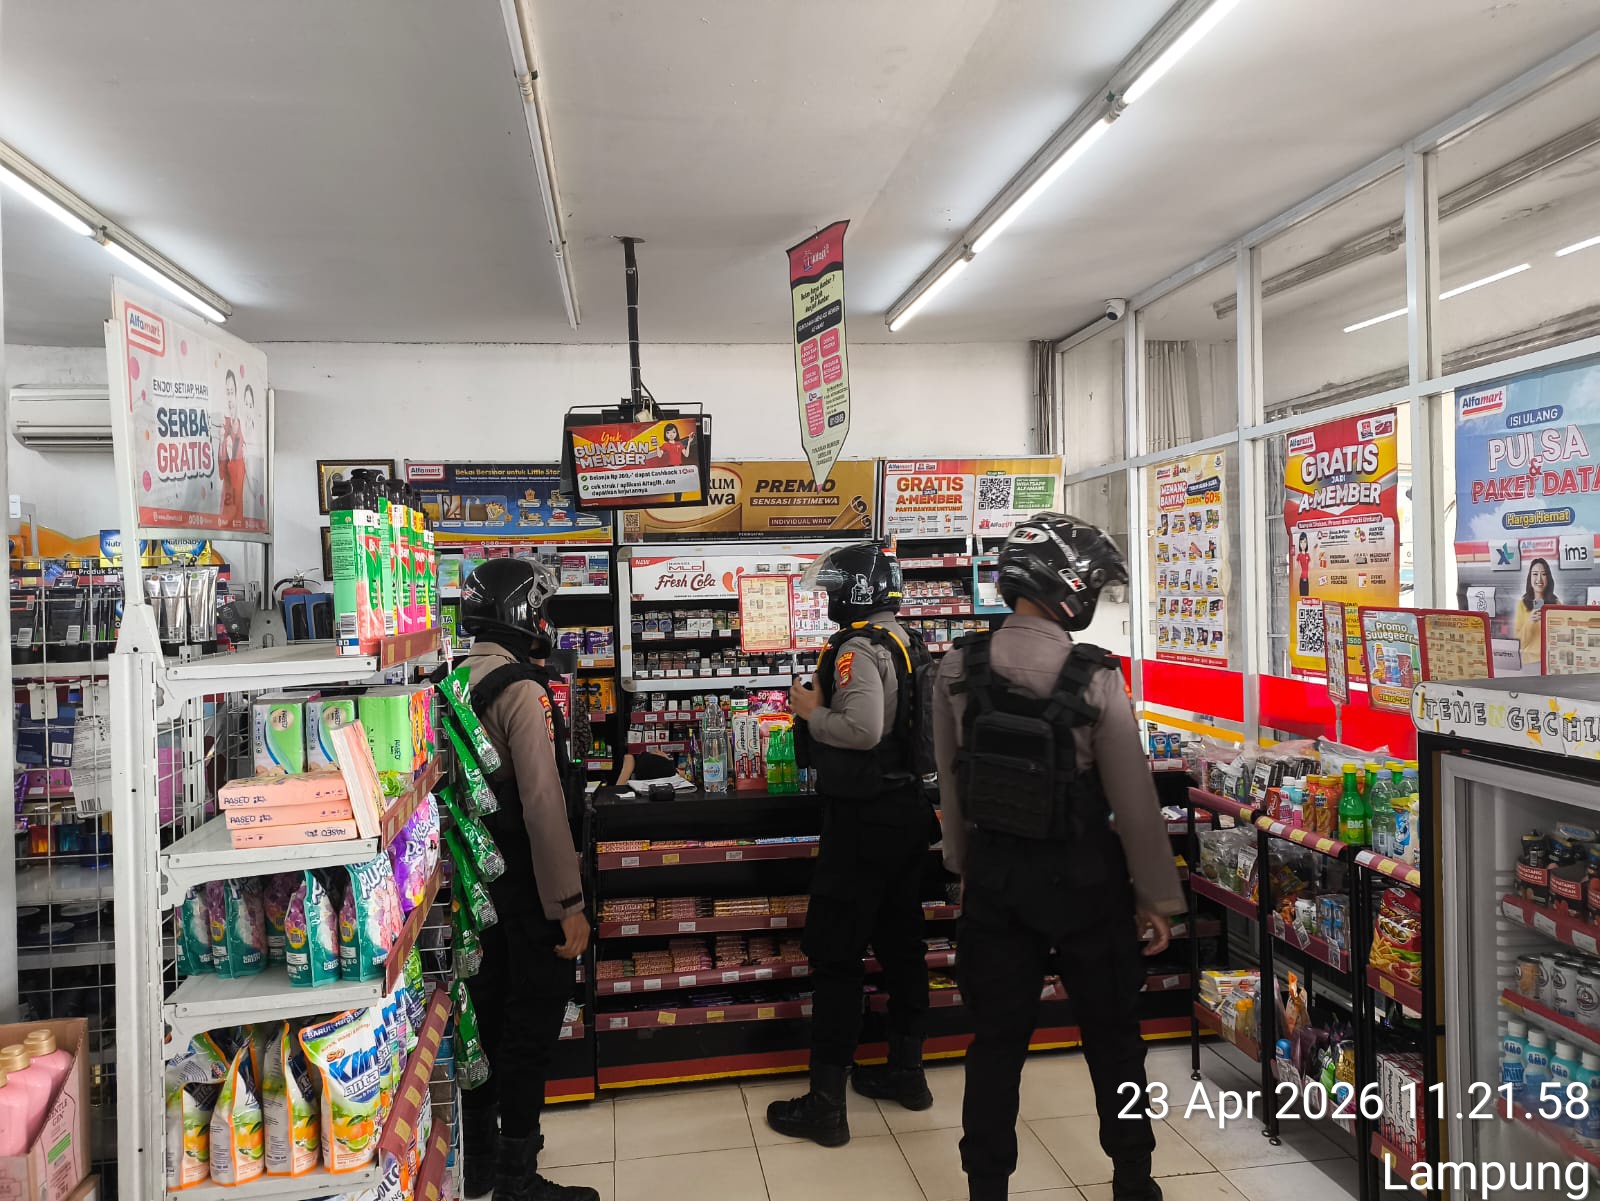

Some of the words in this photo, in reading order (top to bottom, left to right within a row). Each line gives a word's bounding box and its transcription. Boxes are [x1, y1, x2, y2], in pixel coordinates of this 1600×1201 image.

[129, 313, 161, 338] Alfamart
[174, 381, 194, 394] SETIAP
[195, 383, 209, 395] HARI
[1462, 391, 1503, 409] Alfamart
[157, 407, 209, 438] SERBA
[1510, 416, 1521, 426] ISI
[1523, 408, 1558, 424] ULANG
[574, 441, 649, 459] GUNAKAN
[1290, 436, 1313, 448] Alfamart
[1488, 424, 1589, 472] PULSA
[157, 441, 212, 473] GRATIS
[579, 452, 648, 470] MEMBER
[1301, 443, 1379, 484] GRATIS
[527, 468, 545, 476] Little
[610, 474, 618, 482] Rp
[634, 471, 651, 480] dapat
[652, 469, 678, 478] Cashback
[1529, 458, 1543, 476] &
[896, 476, 964, 492] GRATIS
[1161, 482, 1187, 495] MENANG
[1472, 474, 1540, 504] PAKET
[1543, 464, 1600, 496] DATA
[752, 497, 791, 506] SENSASI
[792, 497, 838, 505] ISTIMEWA
[1160, 492, 1185, 506] BANYAK
[771, 518, 811, 526] INDIVIDUAL
[1506, 512, 1535, 526] Harga
[1535, 510, 1570, 523] Hemat
[1564, 543, 1588, 561] im3
[655, 573, 688, 591] Fresh
[690, 573, 717, 591] Cola
[1376, 622, 1408, 633] Promo
[230, 815, 256, 824] PASEO
[1347, 820, 1364, 829] BIG
